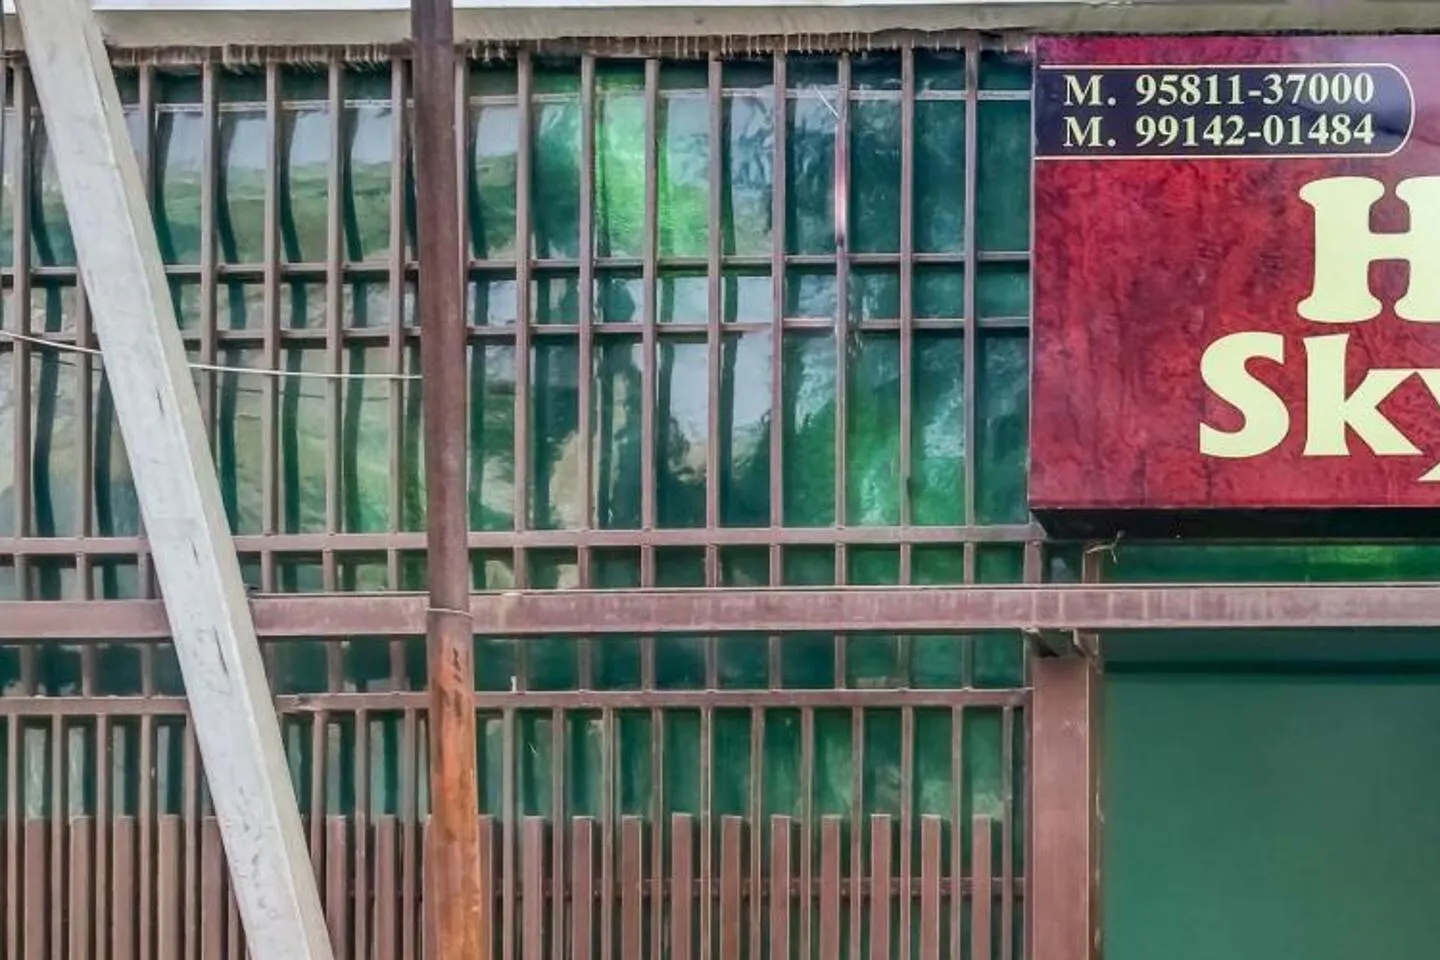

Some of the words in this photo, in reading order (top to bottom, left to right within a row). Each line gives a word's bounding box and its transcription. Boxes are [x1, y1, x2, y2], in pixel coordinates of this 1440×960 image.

[1063, 75, 1116, 105] M.
[1135, 72, 1375, 105] 95811-37000
[1063, 116, 1116, 147] M.
[1135, 113, 1375, 147] 99142-01484
